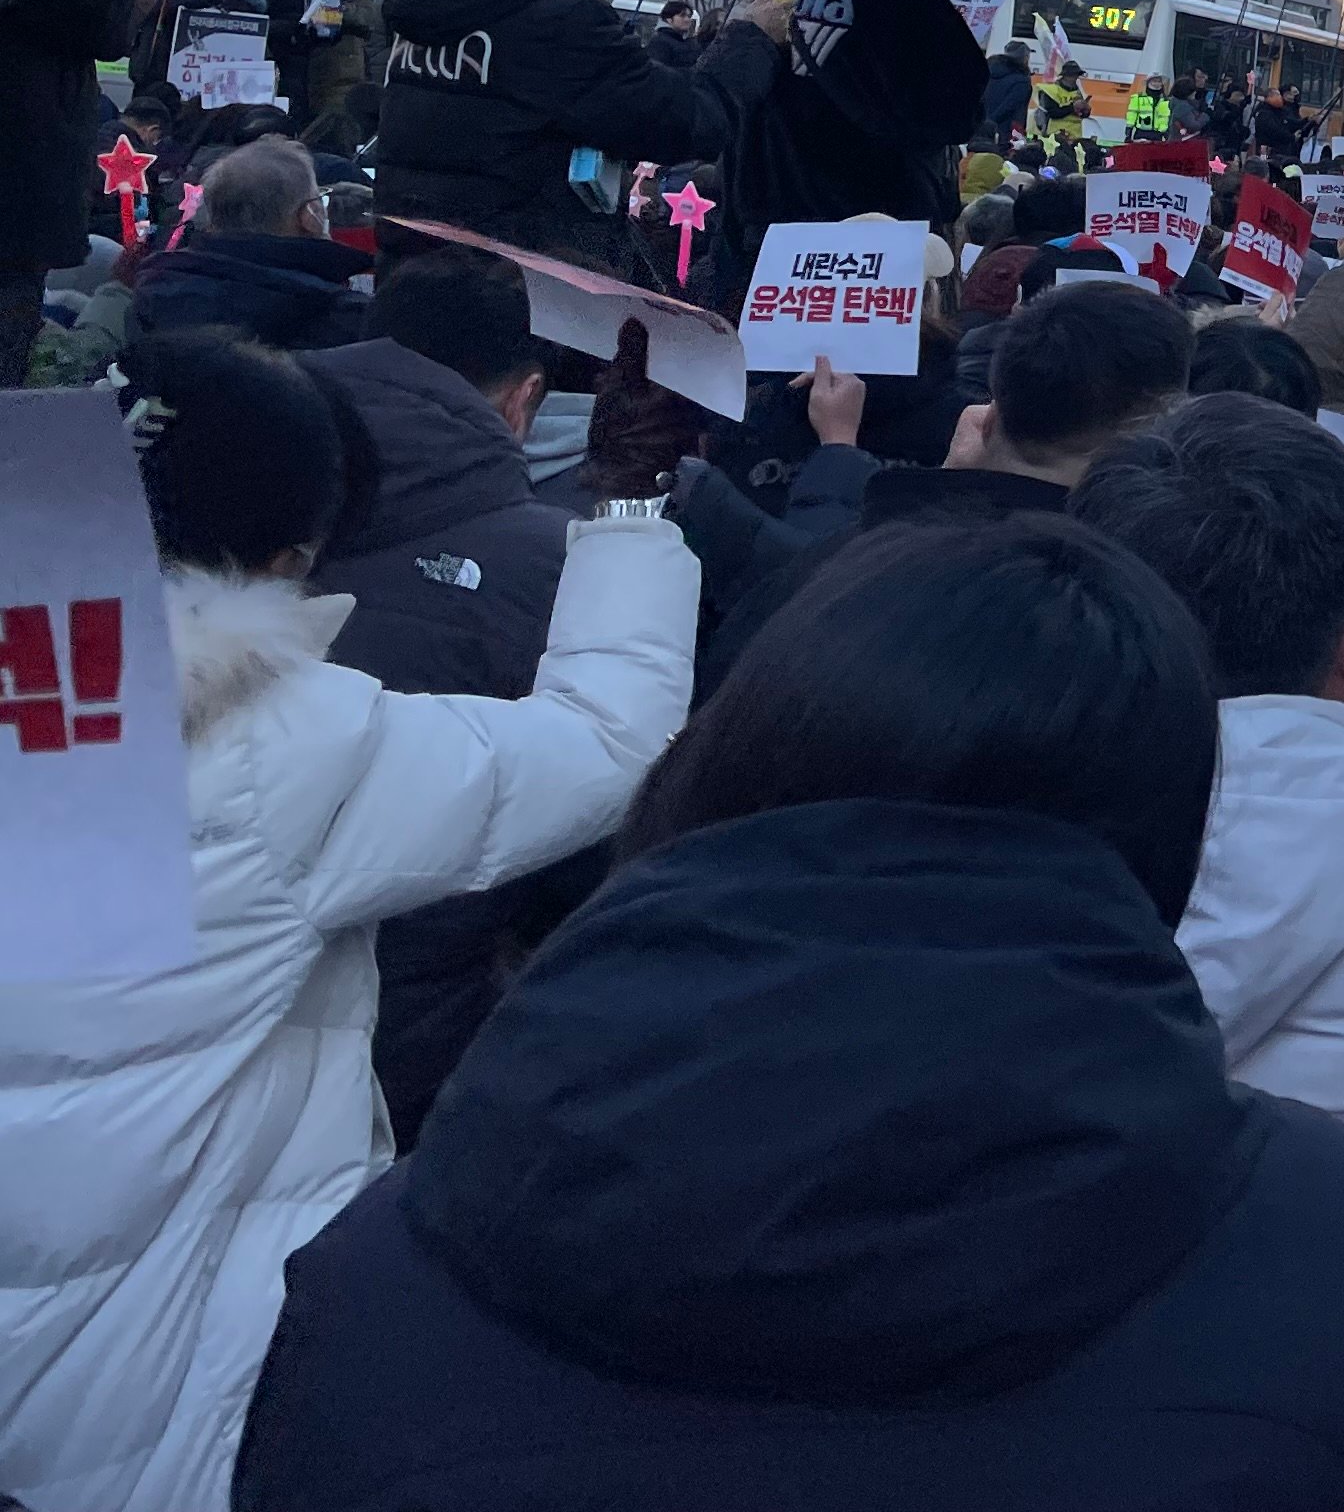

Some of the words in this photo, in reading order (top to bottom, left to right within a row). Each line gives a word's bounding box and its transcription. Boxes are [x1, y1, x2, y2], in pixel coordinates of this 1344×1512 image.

[1089, 6, 1137, 31] 307
[1118, 190, 1189, 212] 내란수괴
[1090, 211, 1161, 238] 윤석열
[1165, 213, 1201, 246] 탄핵!
[1233, 221, 1283, 267] 윤석열
[791, 251, 883, 280] 내란수괴
[749, 285, 835, 322] 윤석열
[842, 285, 916, 325] 탄핵!
